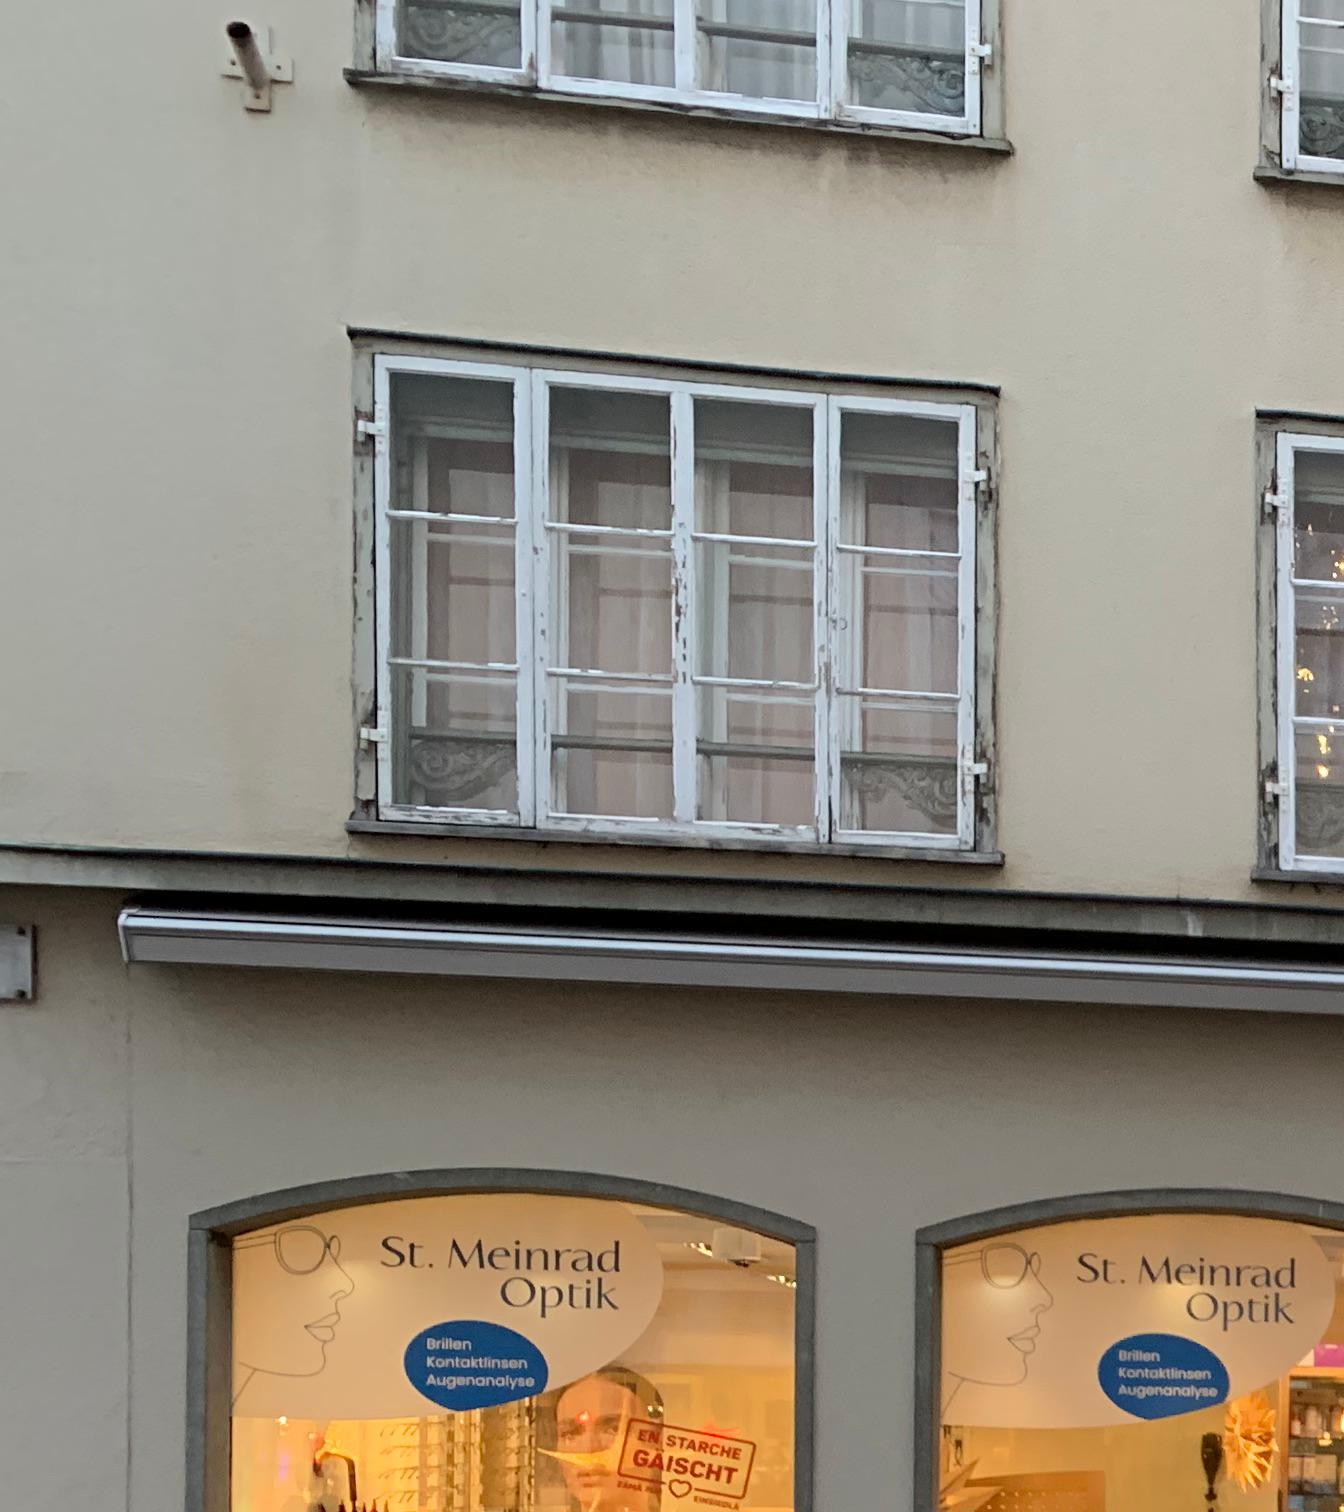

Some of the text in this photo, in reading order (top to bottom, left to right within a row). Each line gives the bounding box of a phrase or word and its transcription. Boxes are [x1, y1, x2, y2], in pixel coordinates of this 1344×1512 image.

[380, 1235, 621, 1272] St. Meinrad
[1075, 1252, 1296, 1289] St. Meinrad
[500, 1276, 619, 1318] Optik
[1186, 1291, 1295, 1332] Optik
[426, 1337, 472, 1351] Brillen
[1118, 1349, 1161, 1362] Brillen
[426, 1356, 528, 1370] Kontaktlinsen
[1118, 1366, 1212, 1381] Kontaktlinsen
[426, 1373, 536, 1390] Augenanalyse
[1117, 1383, 1219, 1400] Augenanalyse
[637, 1429, 742, 1461] EN STARCHE
[632, 1448, 739, 1485] GÄISCHT
